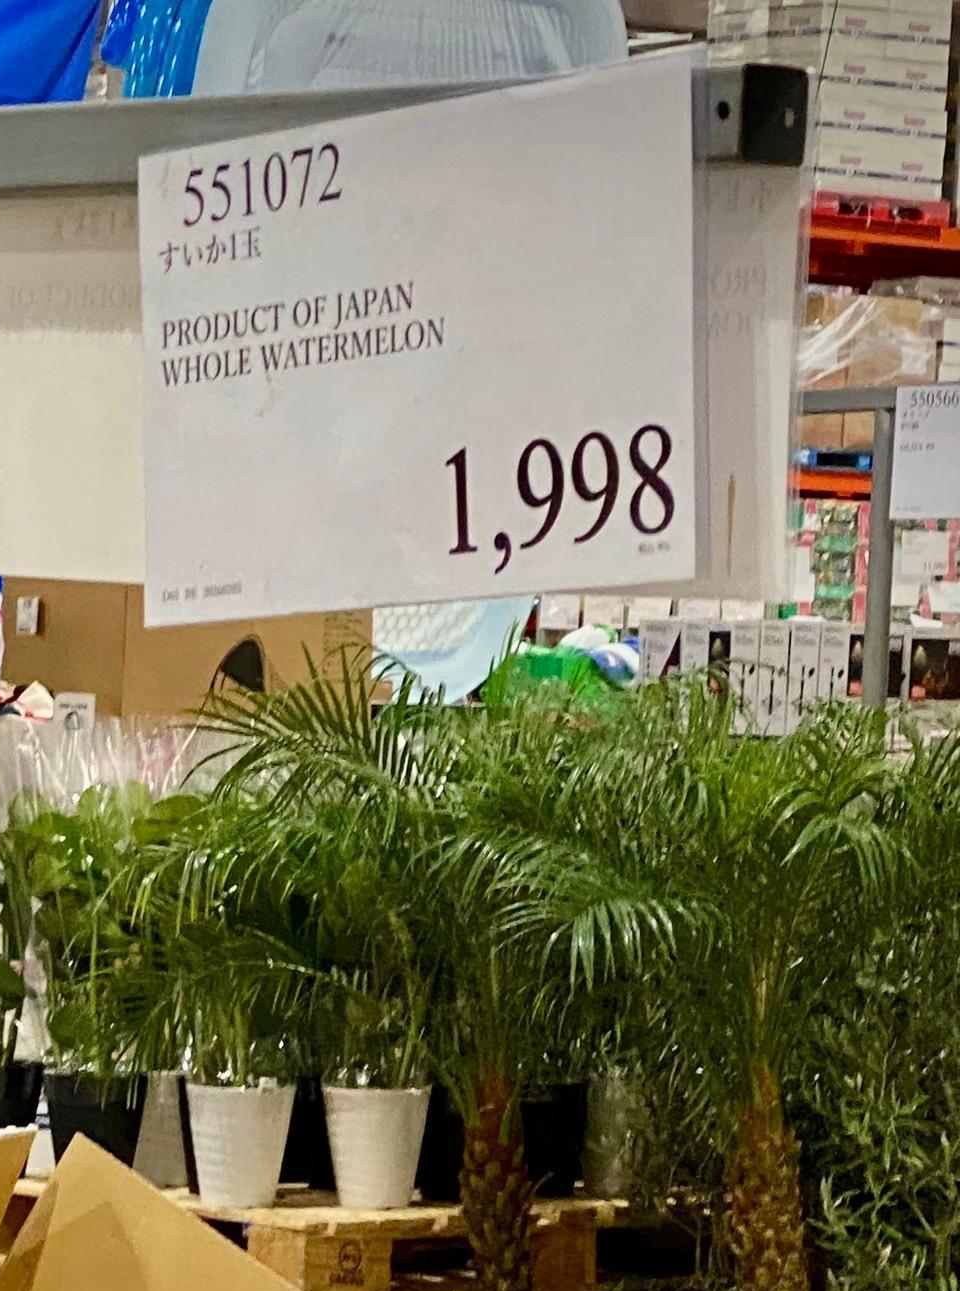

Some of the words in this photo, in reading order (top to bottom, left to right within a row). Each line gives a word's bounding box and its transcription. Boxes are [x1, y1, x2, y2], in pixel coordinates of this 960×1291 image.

[183, 143, 342, 227] 551072
[158, 226, 262, 274] すいか1玉
[161, 303, 285, 349] PRODUCT
[292, 296, 327, 329] OF
[334, 281, 414, 330] JAPAN
[161, 348, 252, 388] WHOLE
[261, 317, 445, 373] WATERMELON
[444, 424, 676, 576] 1,998
